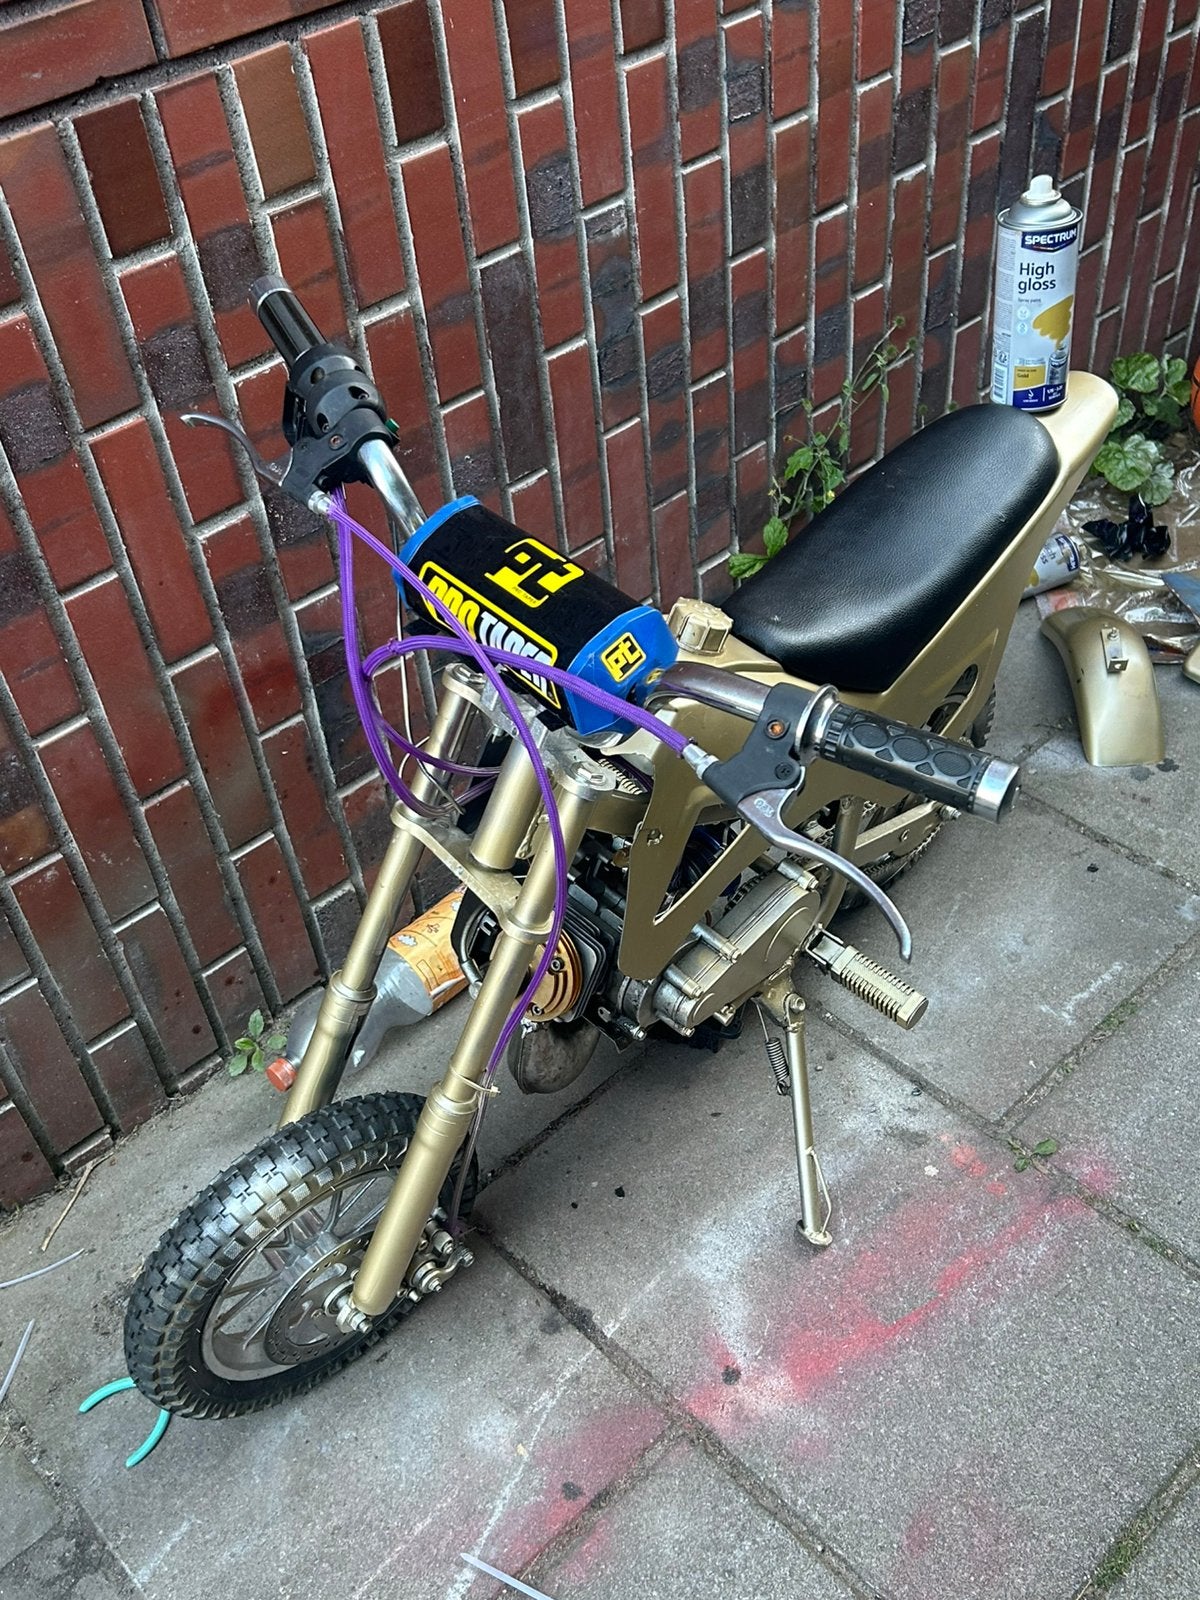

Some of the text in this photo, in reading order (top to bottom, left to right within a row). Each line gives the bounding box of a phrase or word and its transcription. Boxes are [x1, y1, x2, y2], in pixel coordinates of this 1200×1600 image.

[1024, 228, 1077, 245] SPECTRUM
[1019, 262, 1055, 279] High
[1018, 278, 1056, 294] gloss
